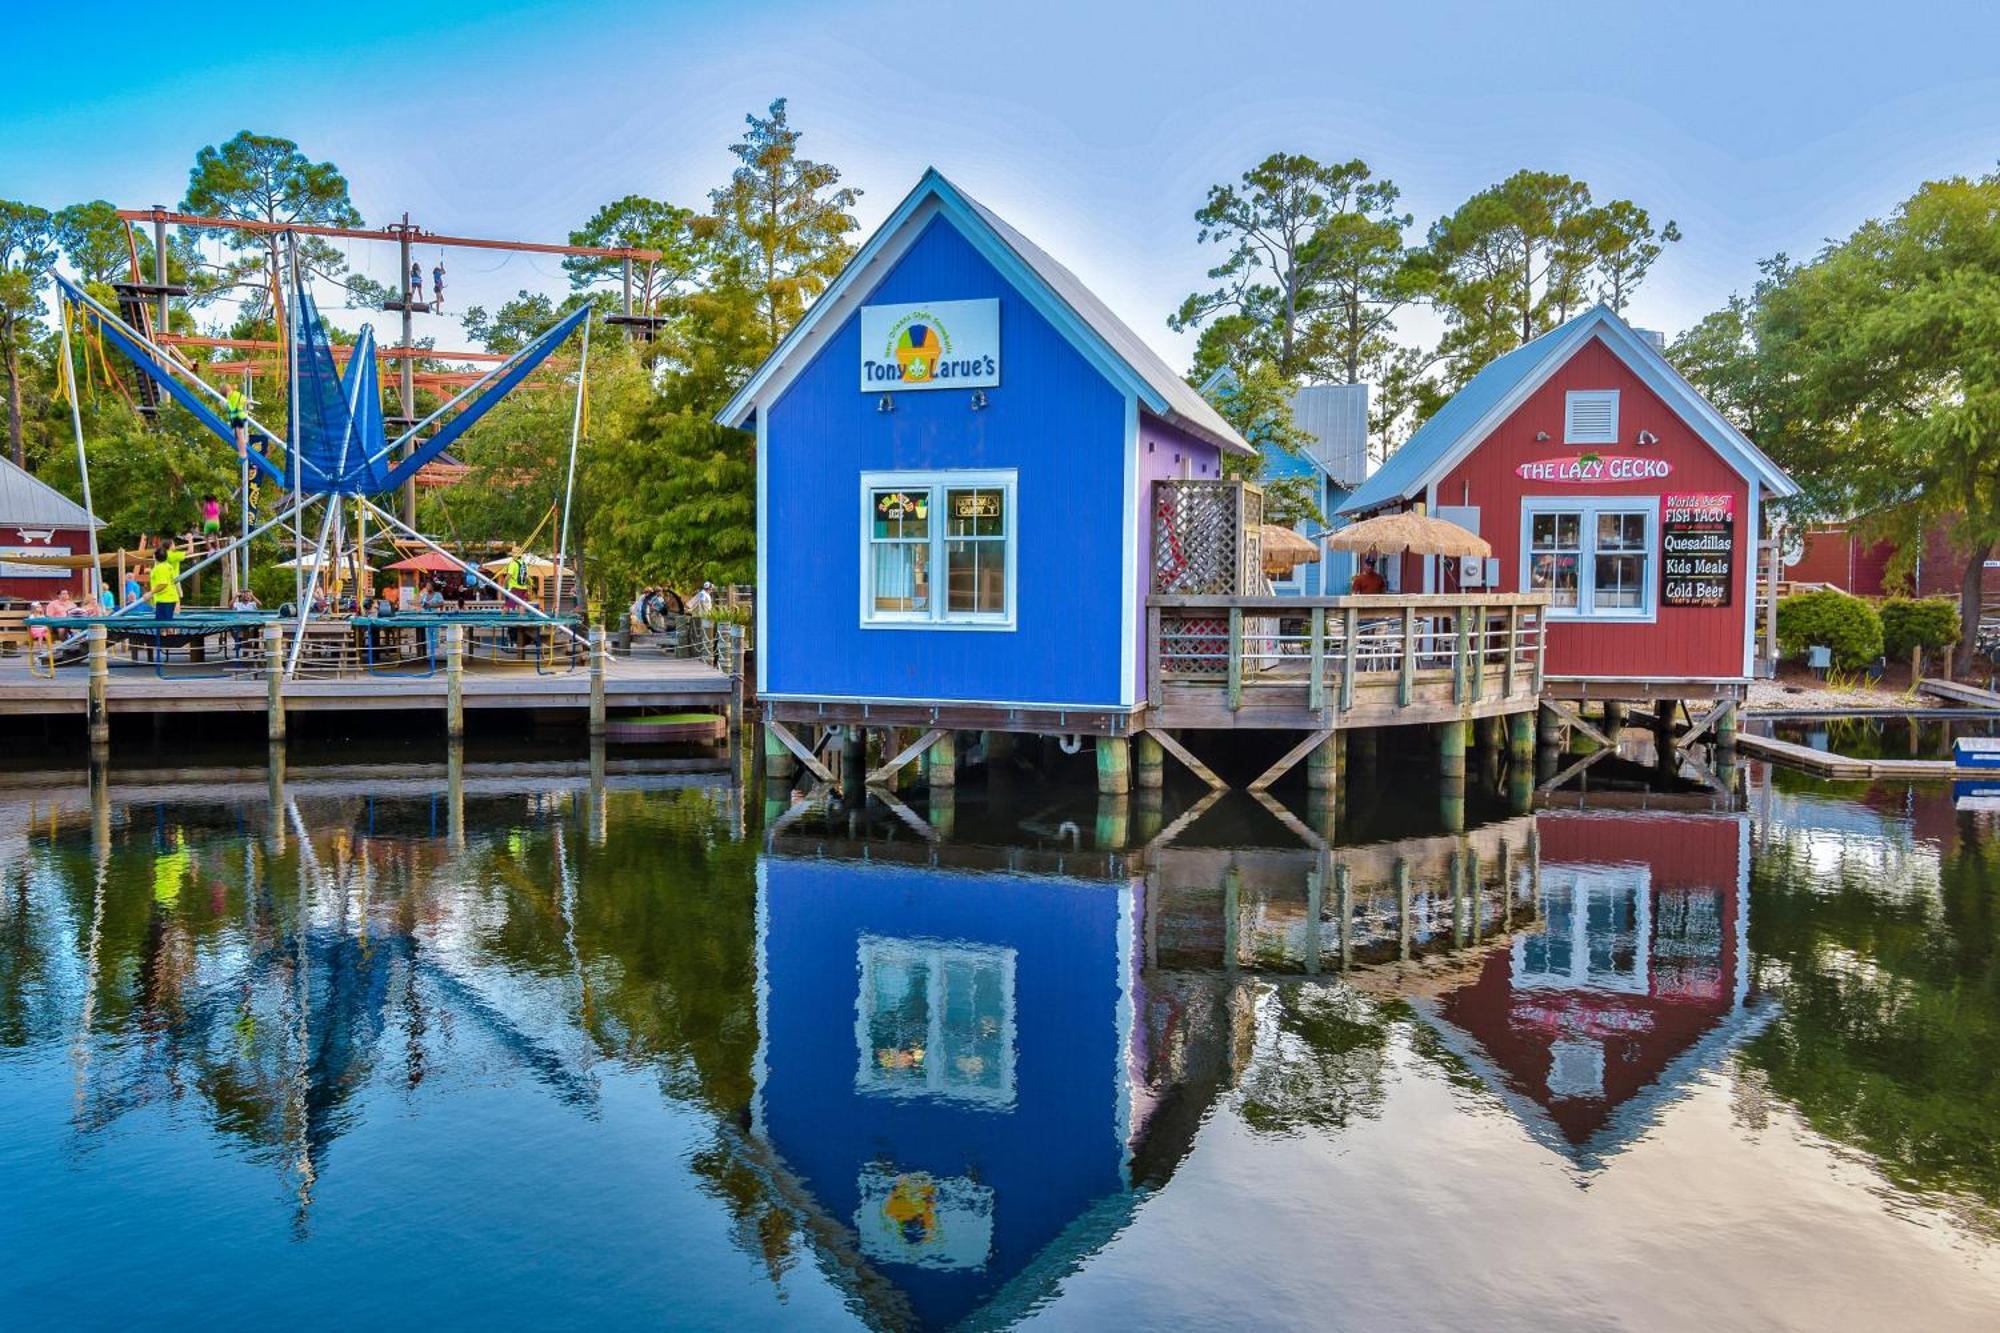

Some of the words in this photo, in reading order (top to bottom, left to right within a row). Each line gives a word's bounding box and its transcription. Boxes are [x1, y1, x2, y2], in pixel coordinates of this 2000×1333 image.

[864, 360, 907, 381] Tony
[929, 355, 995, 379] Larue's
[1520, 463, 1555, 479] THE
[1559, 459, 1606, 479] LAZY
[1609, 459, 1669, 478] GECKO
[1667, 495, 1700, 508] Worlds
[1664, 508, 1690, 523] FISH
[1693, 508, 1733, 522] TACO's
[1664, 535, 1732, 551] Quesadillas
[1666, 560, 1692, 575] Kids
[1694, 559, 1728, 575] Meals
[1666, 582, 1693, 598] Cold
[1696, 582, 1724, 598] Beer
